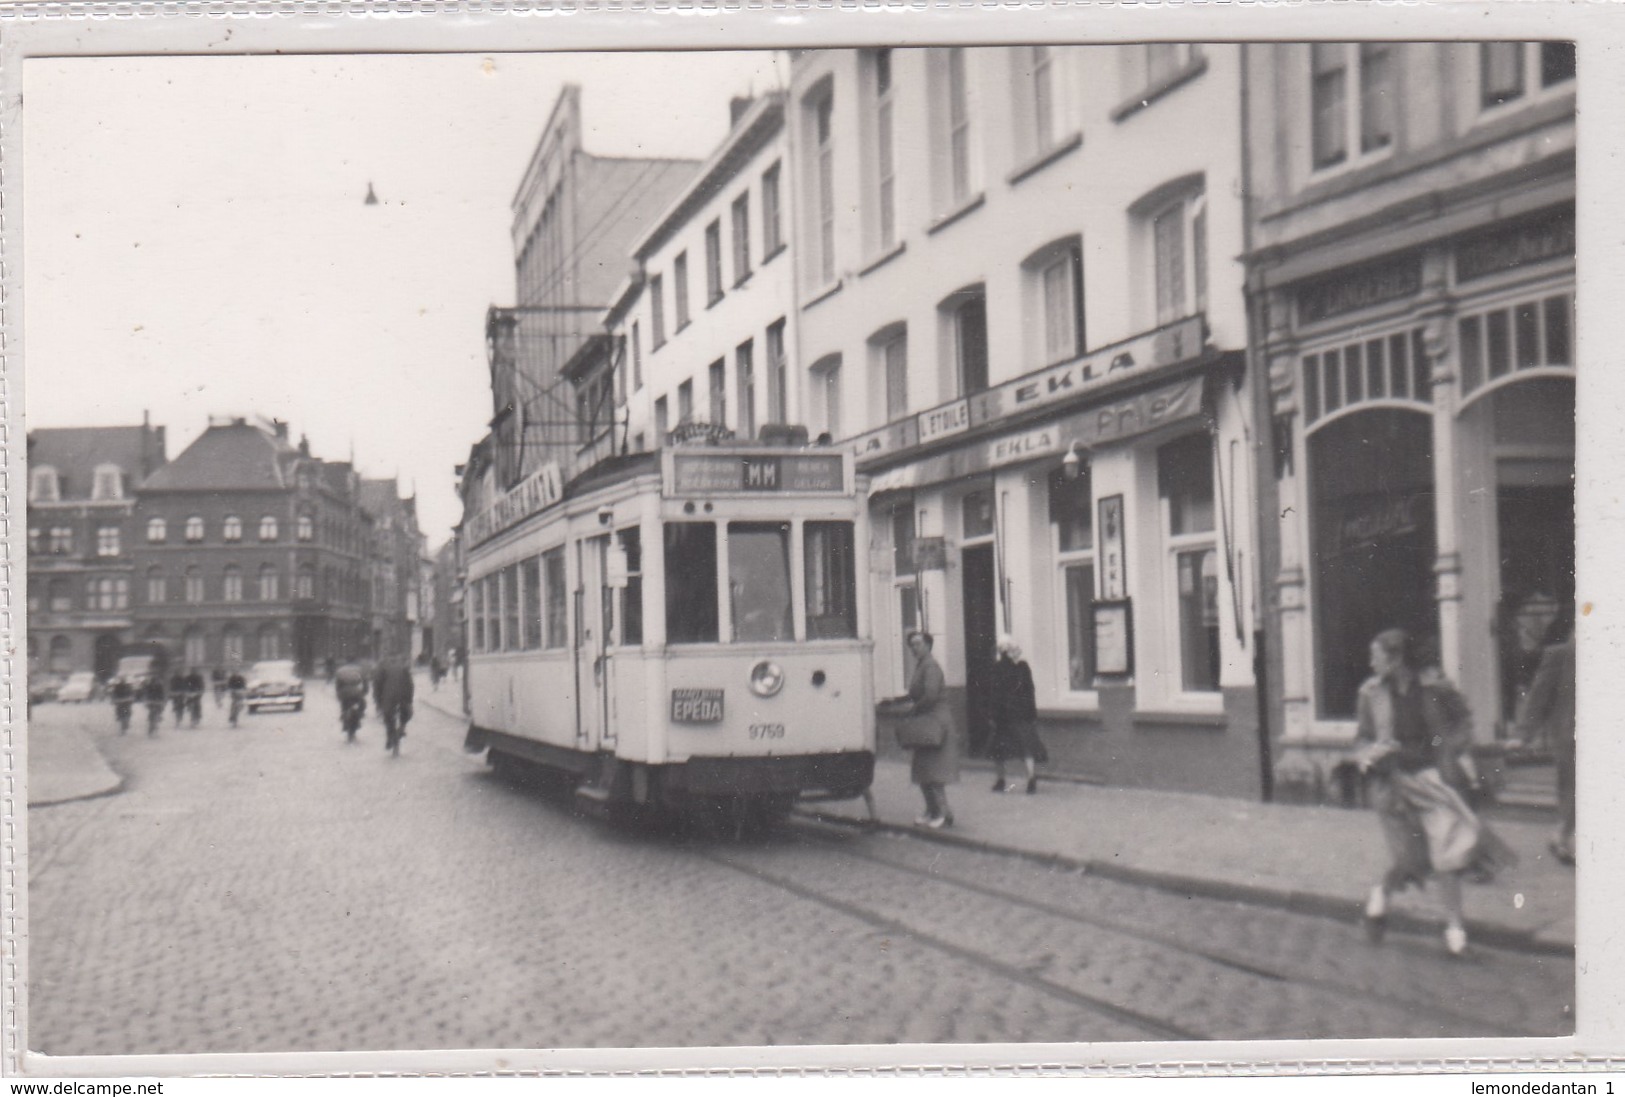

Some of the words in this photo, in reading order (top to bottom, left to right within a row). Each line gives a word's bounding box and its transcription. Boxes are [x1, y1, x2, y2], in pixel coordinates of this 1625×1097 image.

[1015, 351, 1136, 404] EKLA
[996, 432, 1051, 459] EKLA
[749, 463, 776, 486] MM
